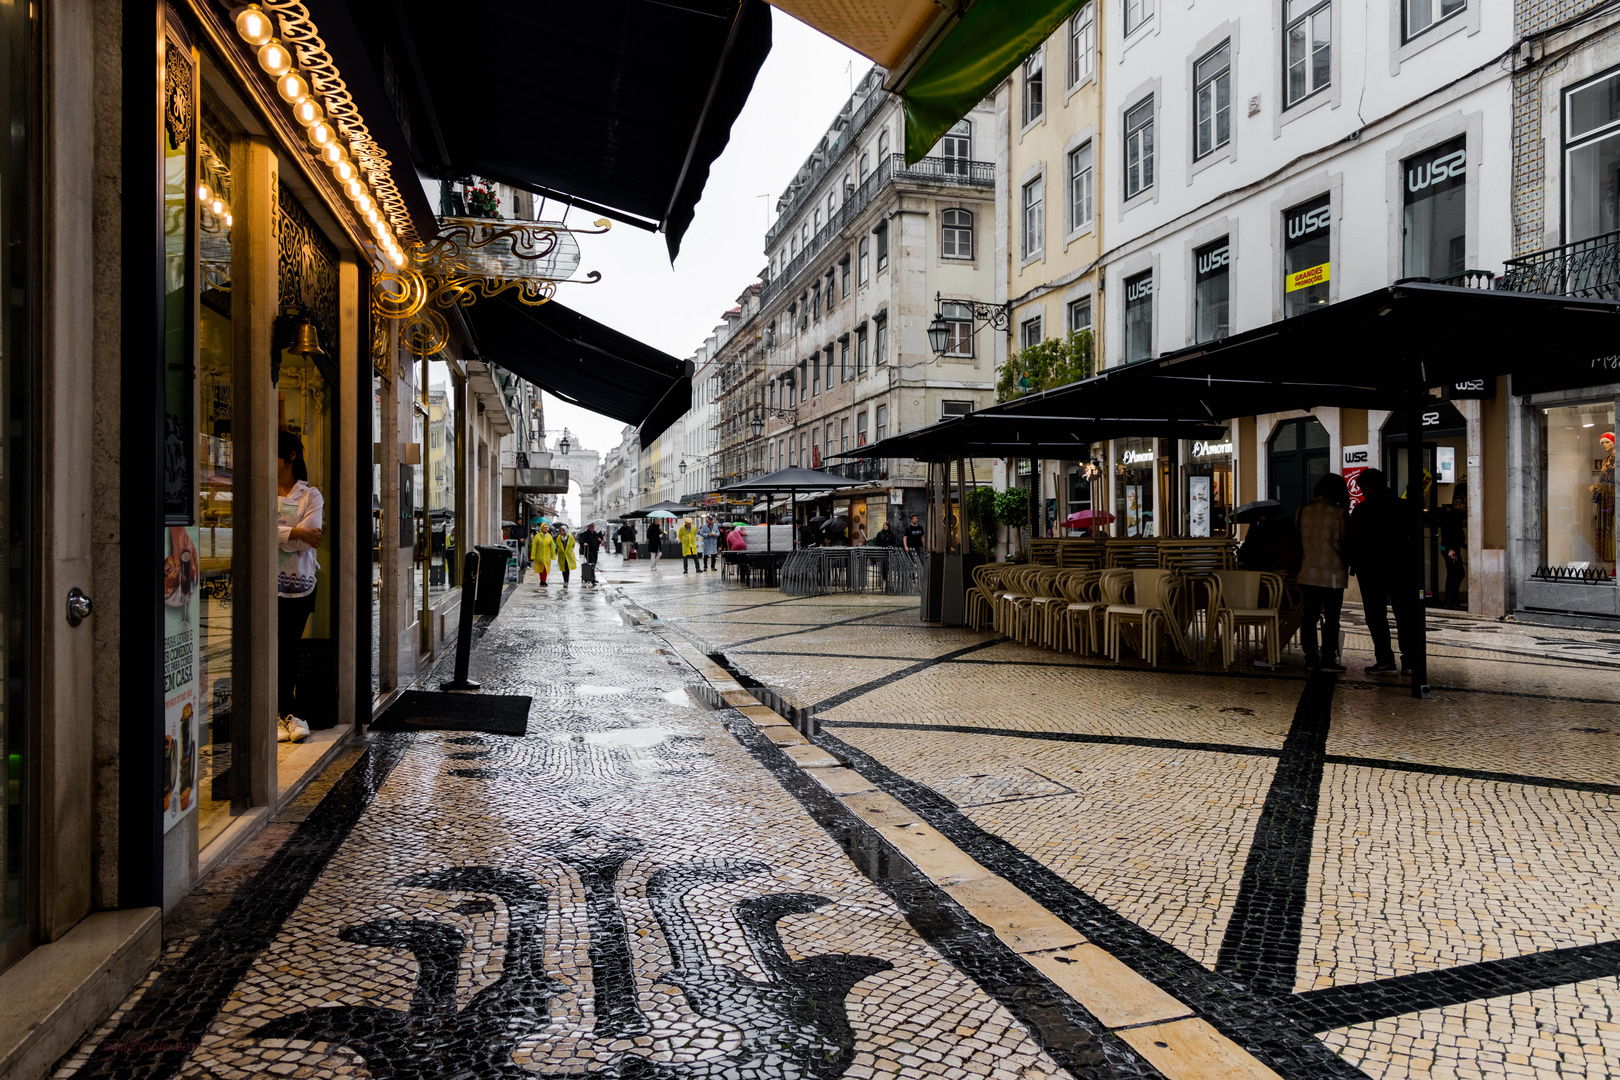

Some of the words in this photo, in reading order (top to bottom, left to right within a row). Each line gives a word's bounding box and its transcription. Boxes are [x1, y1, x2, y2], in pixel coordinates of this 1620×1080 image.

[1295, 266, 1322, 281] GRANDES
[1295, 274, 1322, 287] PROMOÇÕES
[170, 642, 193, 661] COMENDO
[164, 672, 175, 693] EM
[176, 665, 193, 687] CASA
